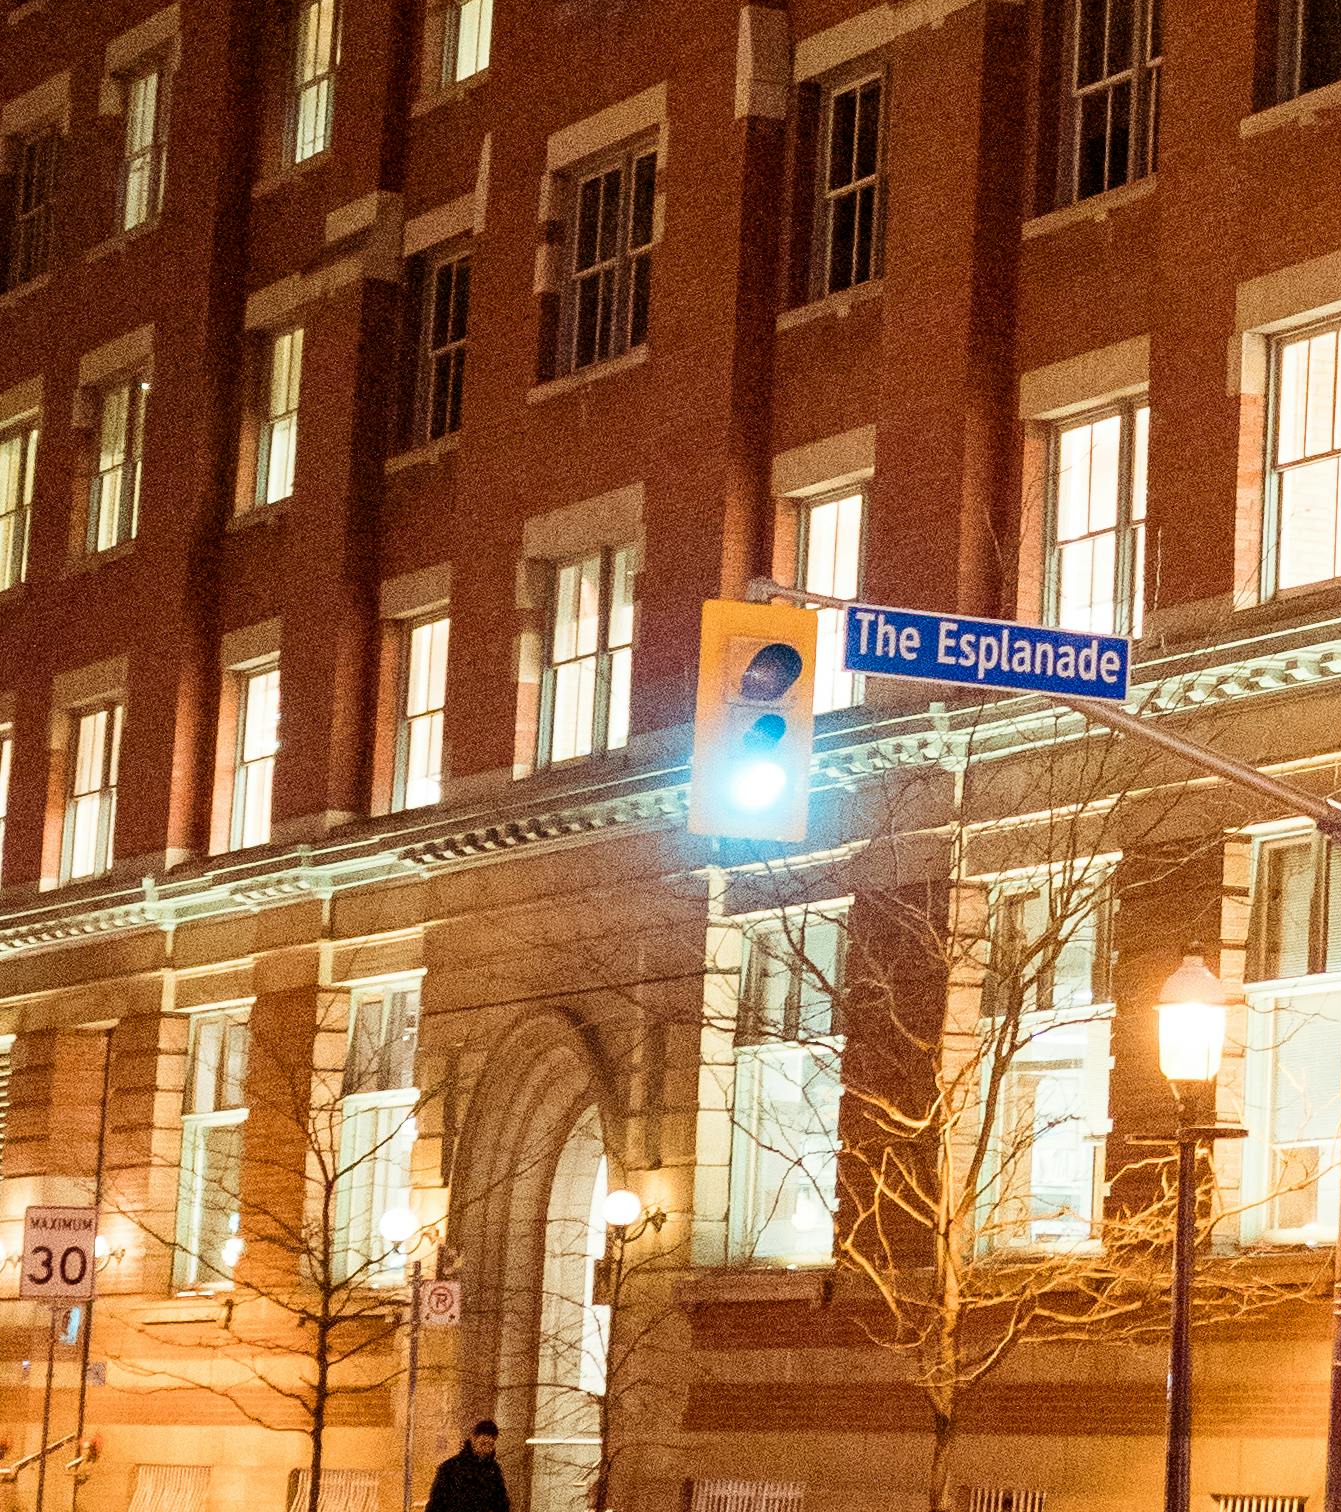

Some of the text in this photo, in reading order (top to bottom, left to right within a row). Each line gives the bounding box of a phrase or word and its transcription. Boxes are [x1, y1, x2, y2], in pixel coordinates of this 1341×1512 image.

[855, 611, 1121, 684] The Esplanade
[30, 1217, 92, 1231] MAXIMUM
[28, 1245, 87, 1286] 30
